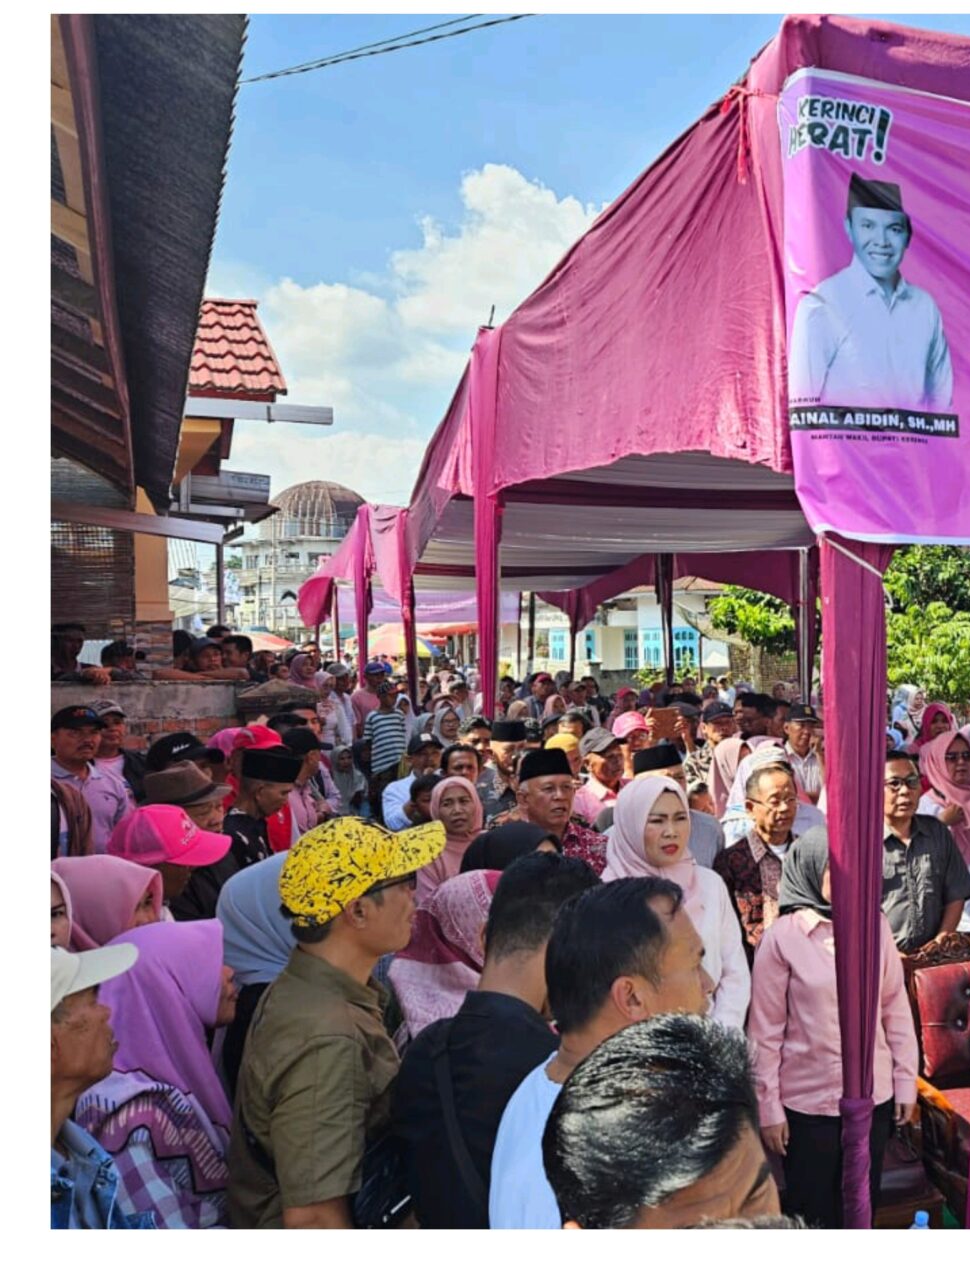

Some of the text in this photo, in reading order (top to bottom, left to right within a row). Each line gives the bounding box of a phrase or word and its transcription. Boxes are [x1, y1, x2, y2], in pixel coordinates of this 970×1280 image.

[799, 98, 875, 125] KERINCI
[844, 413, 904, 430] ABIDIN,
[908, 416, 957, 433] SH.,MH
